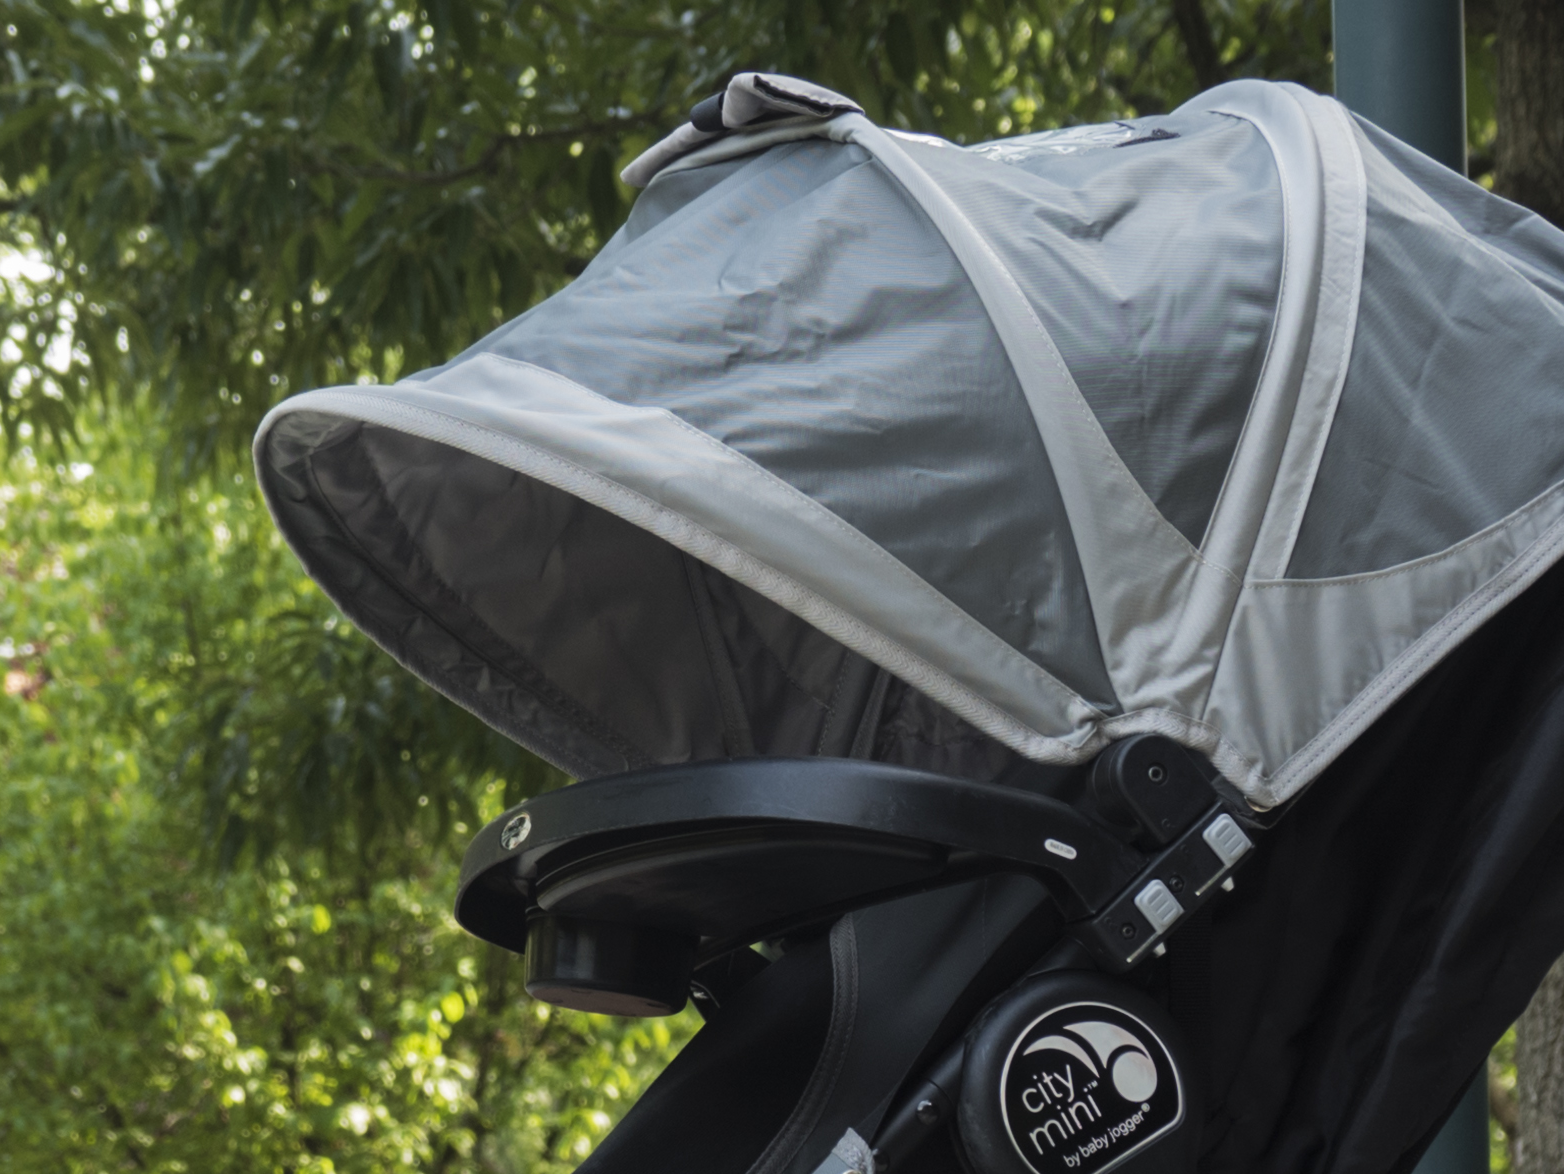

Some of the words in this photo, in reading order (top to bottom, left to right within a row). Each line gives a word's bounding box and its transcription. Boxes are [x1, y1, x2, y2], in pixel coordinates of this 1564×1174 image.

[1021, 1063, 1075, 1112] city
[1063, 1155, 1081, 1167] by
[1078, 1136, 1109, 1157] baby
